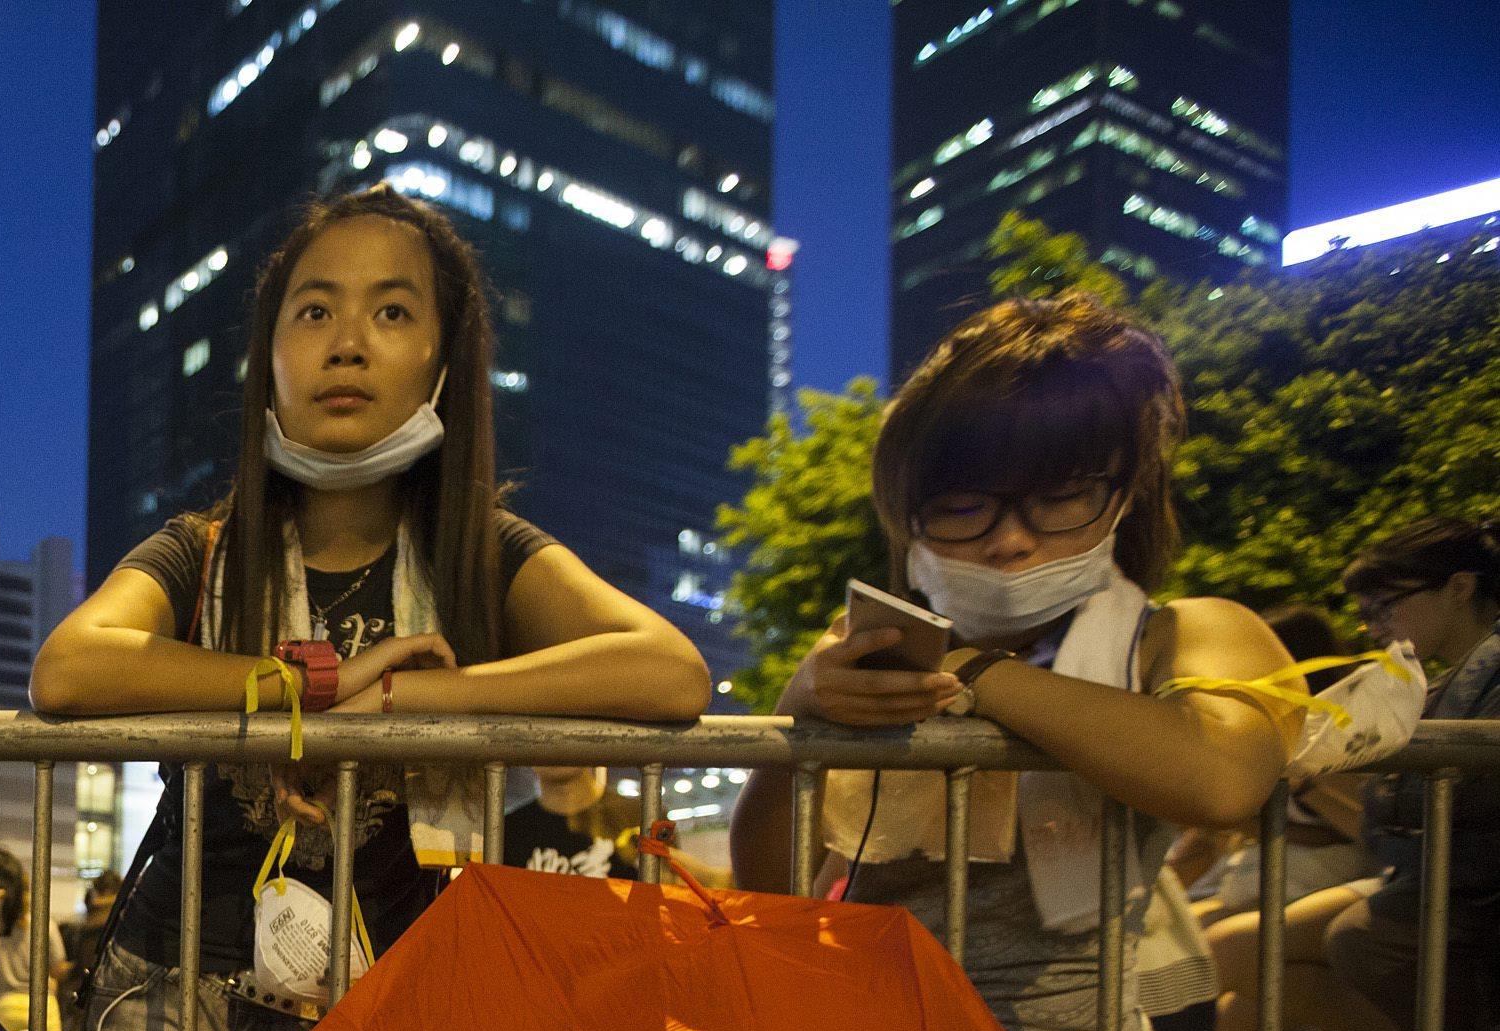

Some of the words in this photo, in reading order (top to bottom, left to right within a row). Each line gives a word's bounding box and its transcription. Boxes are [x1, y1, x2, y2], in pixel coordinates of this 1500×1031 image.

[270, 908, 293, 933] N95
[300, 919, 318, 940] 8210
[272, 942, 299, 977] WARNING
